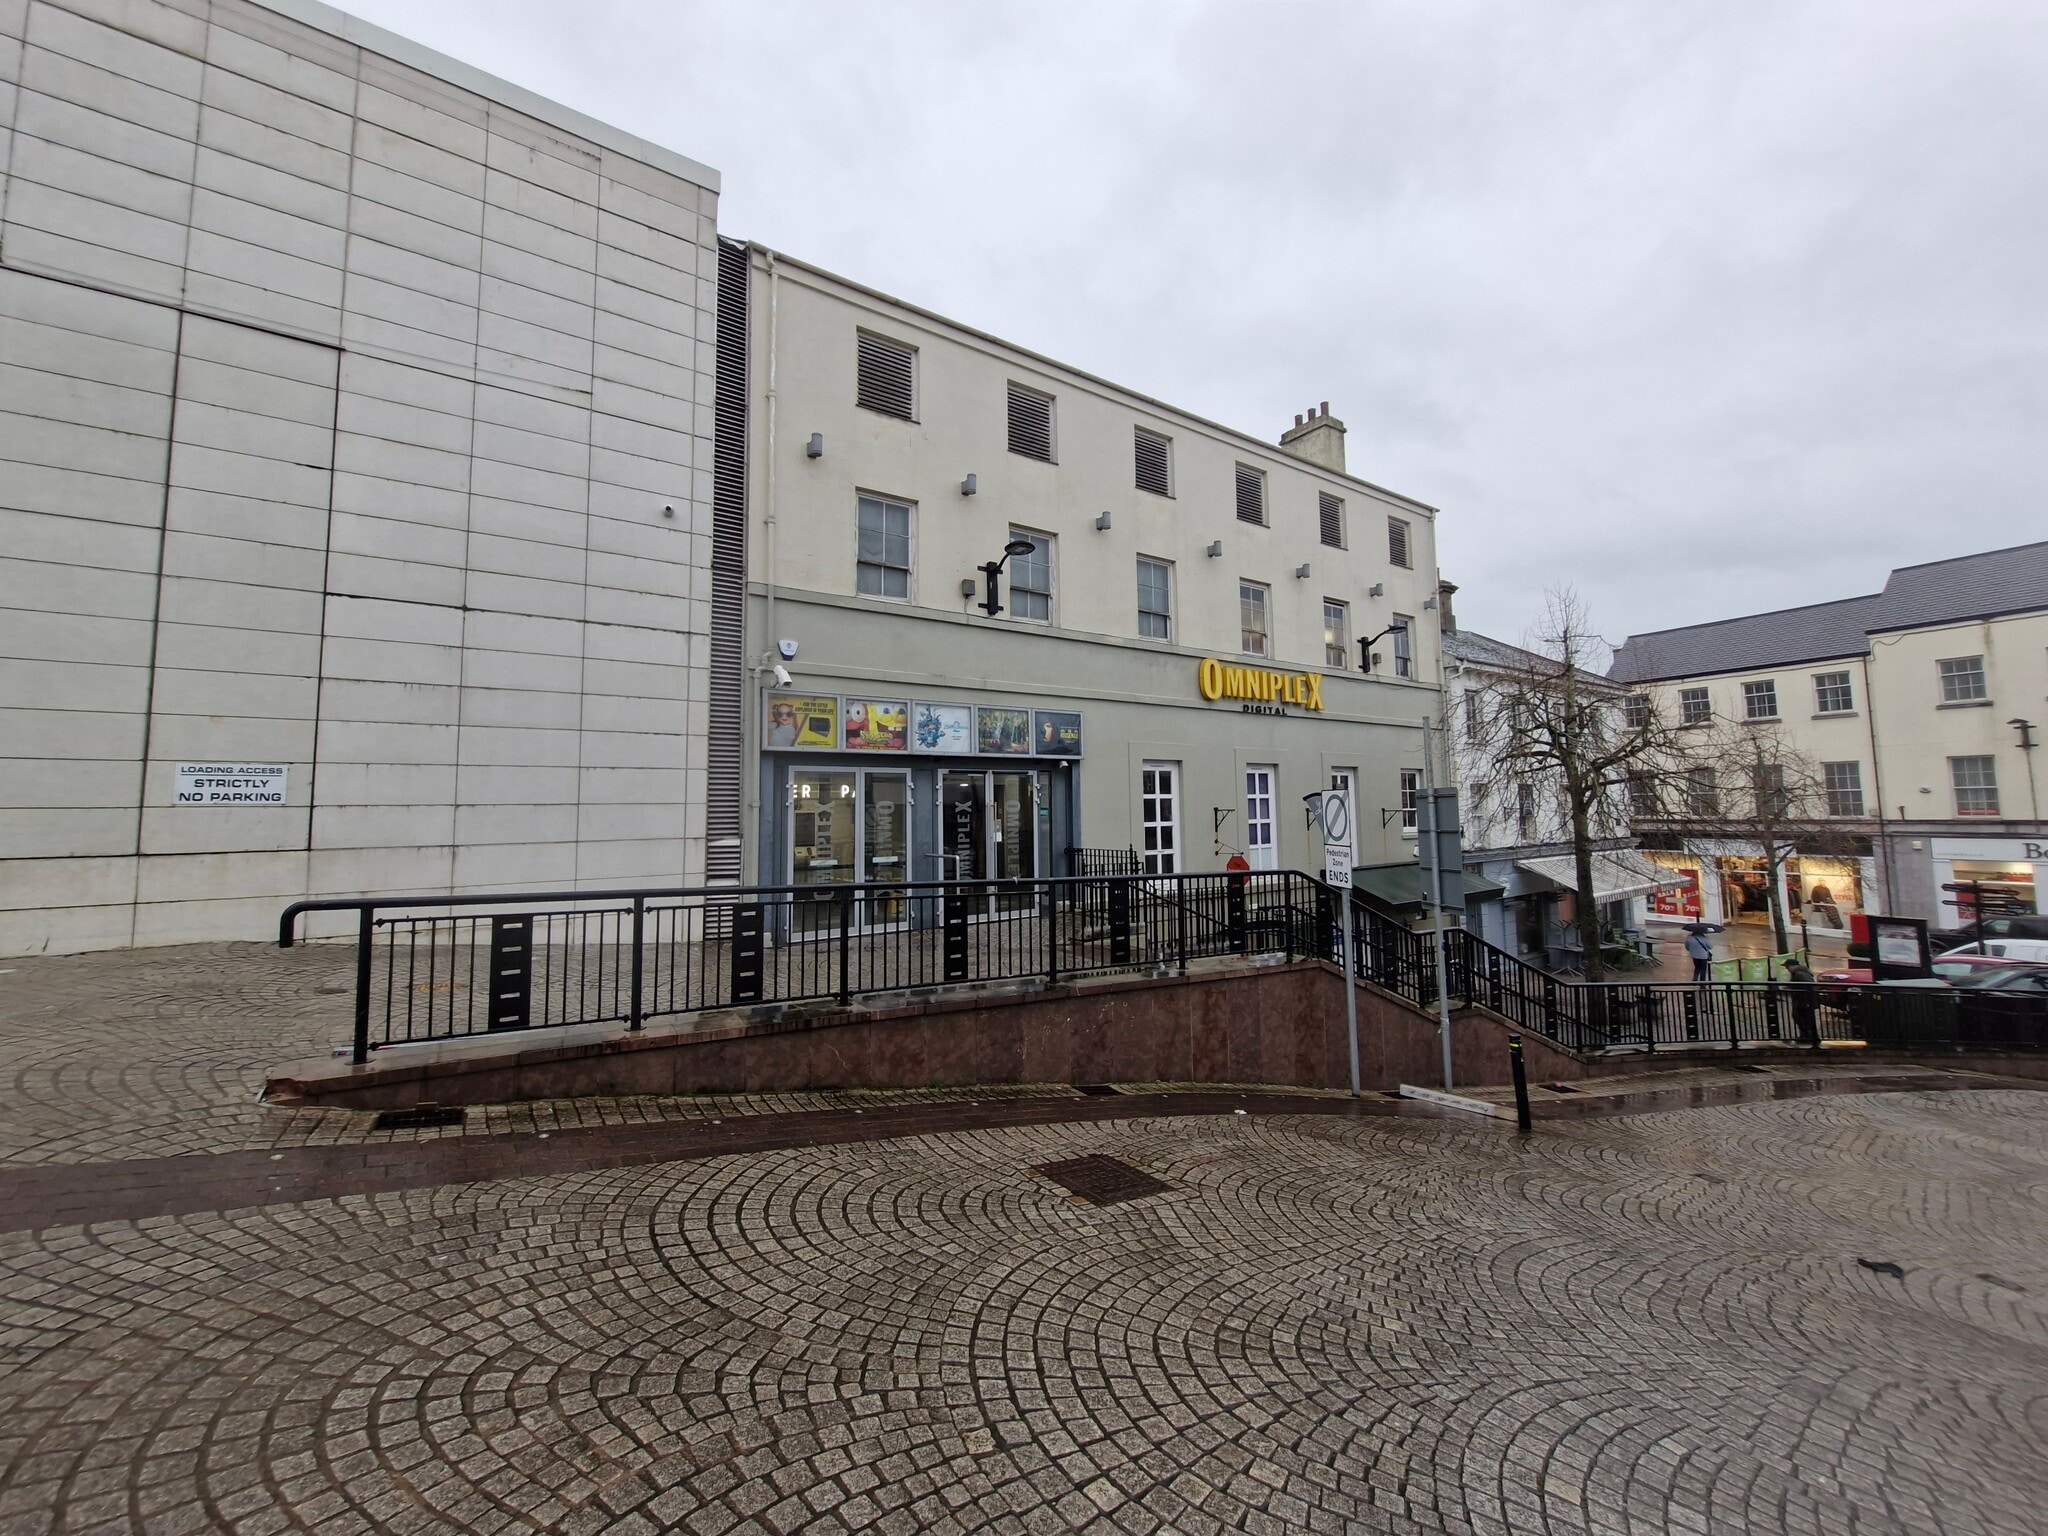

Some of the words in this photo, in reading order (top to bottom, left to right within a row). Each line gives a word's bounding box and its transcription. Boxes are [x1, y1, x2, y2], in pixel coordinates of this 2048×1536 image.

[1242, 704, 1288, 716] DIGITAL
[181, 766, 234, 774] LOADING
[193, 779, 270, 788] STRICTLY
[178, 792, 204, 802] NO
[210, 792, 282, 802] PARKING
[1326, 848, 1350, 858] Pedestrian
[1332, 859, 1344, 868] Zone
[1329, 870, 1349, 884] ENDS
